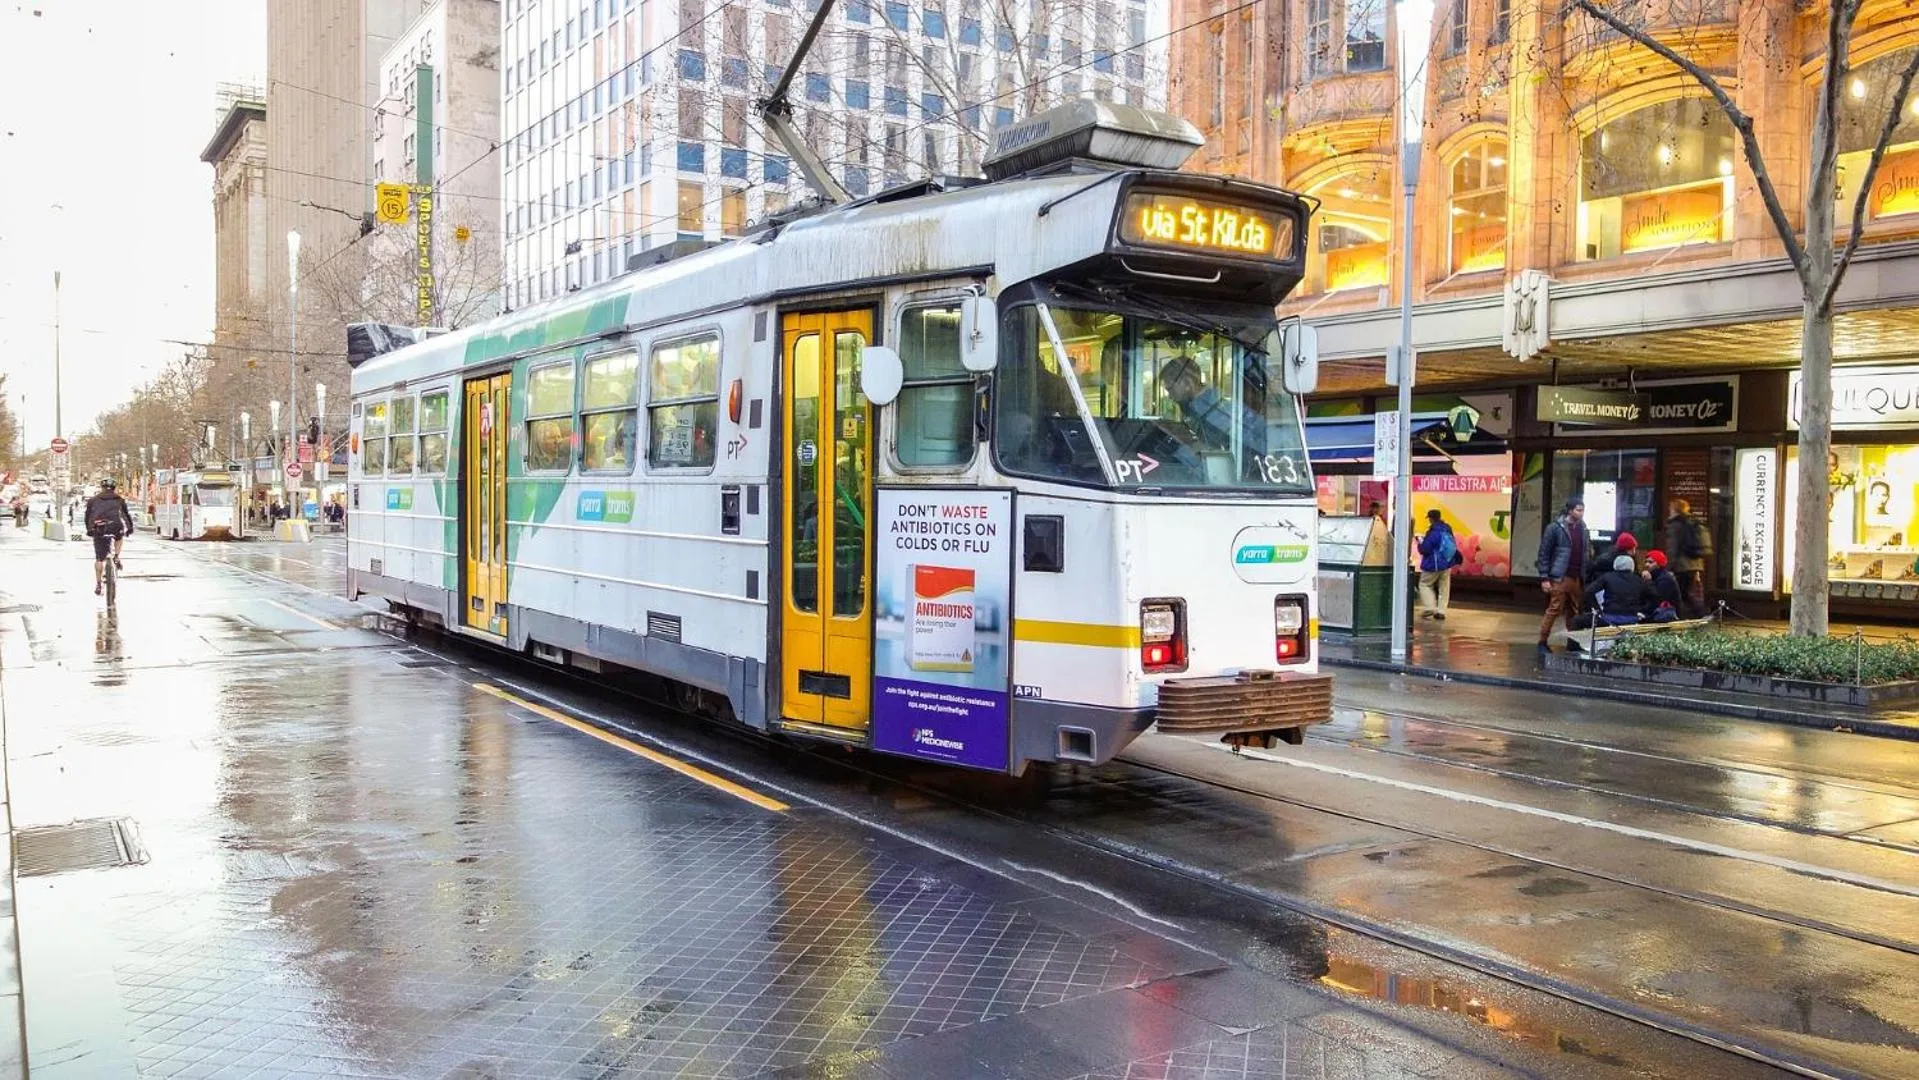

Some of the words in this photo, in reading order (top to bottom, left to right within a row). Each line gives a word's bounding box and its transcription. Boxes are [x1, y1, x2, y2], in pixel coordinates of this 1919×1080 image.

[386, 203, 399, 215] 15
[1142, 205, 1176, 238] via
[1180, 206, 1207, 243] St
[1212, 209, 1265, 250] Kilda
[1563, 402, 1596, 416] TRAVEL
[1597, 404, 1628, 418] MONEY
[727, 441, 740, 460] PT
[1115, 460, 1143, 483] PT
[1418, 477, 1440, 490] JOIN
[1443, 477, 1487, 491] TELSTRA
[1756, 455, 1766, 518] CURRENCY
[581, 498, 600, 516] yarra
[898, 504, 938, 518] DON'T
[941, 505, 988, 519] WASTE
[890, 520, 971, 535] ANTIBIOTICS
[975, 523, 996, 536] ON
[896, 537, 937, 551] COLDS
[941, 539, 960, 552] OR
[964, 540, 990, 553] FLU
[1241, 549, 1268, 560] yarra
[1754, 522, 1764, 585] EXCHANGE
[916, 602, 973, 619] ANTIBIOTICS
[906, 689, 919, 697] fight
[1015, 685, 1041, 697] APN
